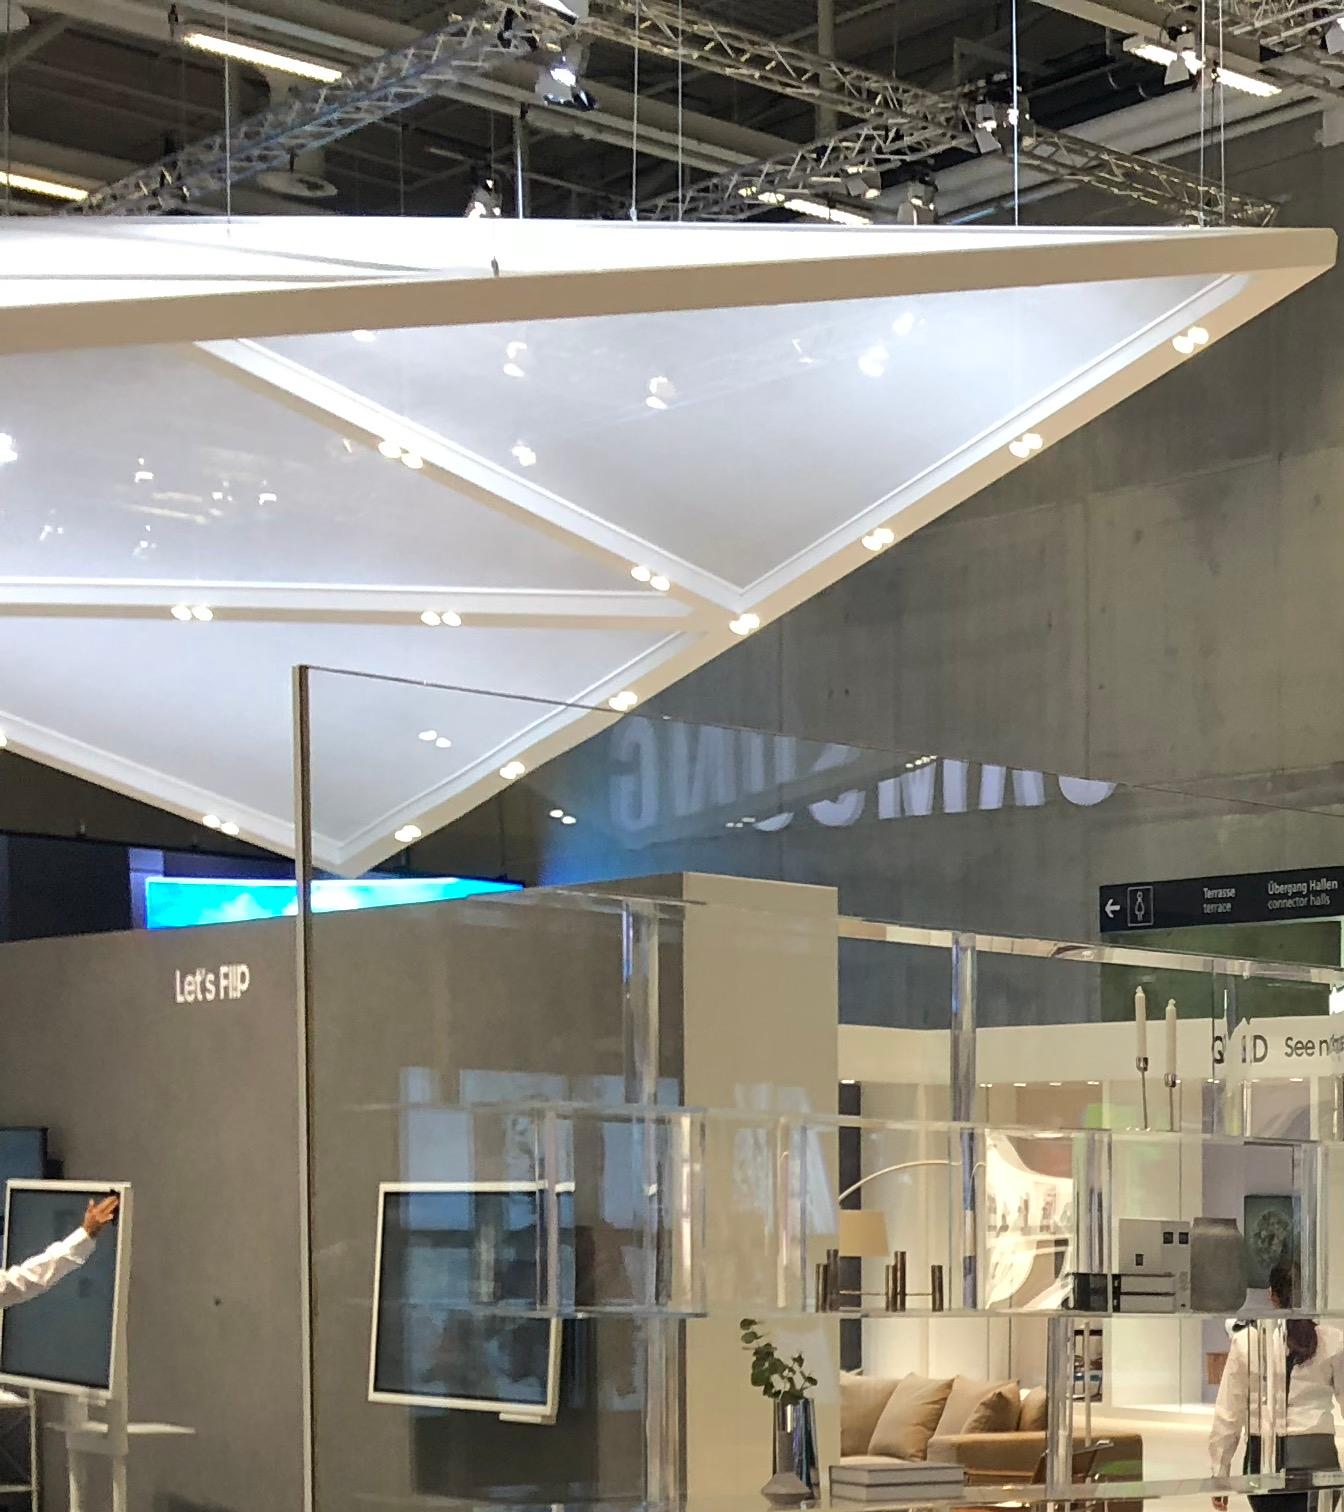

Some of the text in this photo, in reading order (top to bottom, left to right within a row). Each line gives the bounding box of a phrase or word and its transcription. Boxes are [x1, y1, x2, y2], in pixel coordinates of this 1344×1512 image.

[1202, 887, 1236, 899] Terrasse
[1267, 880, 1308, 896] Übergang
[1309, 878, 1338, 891] Hallen
[1202, 902, 1232, 914] terrace
[1267, 893, 1331, 910] connector halls
[1284, 1036, 1315, 1058] See
